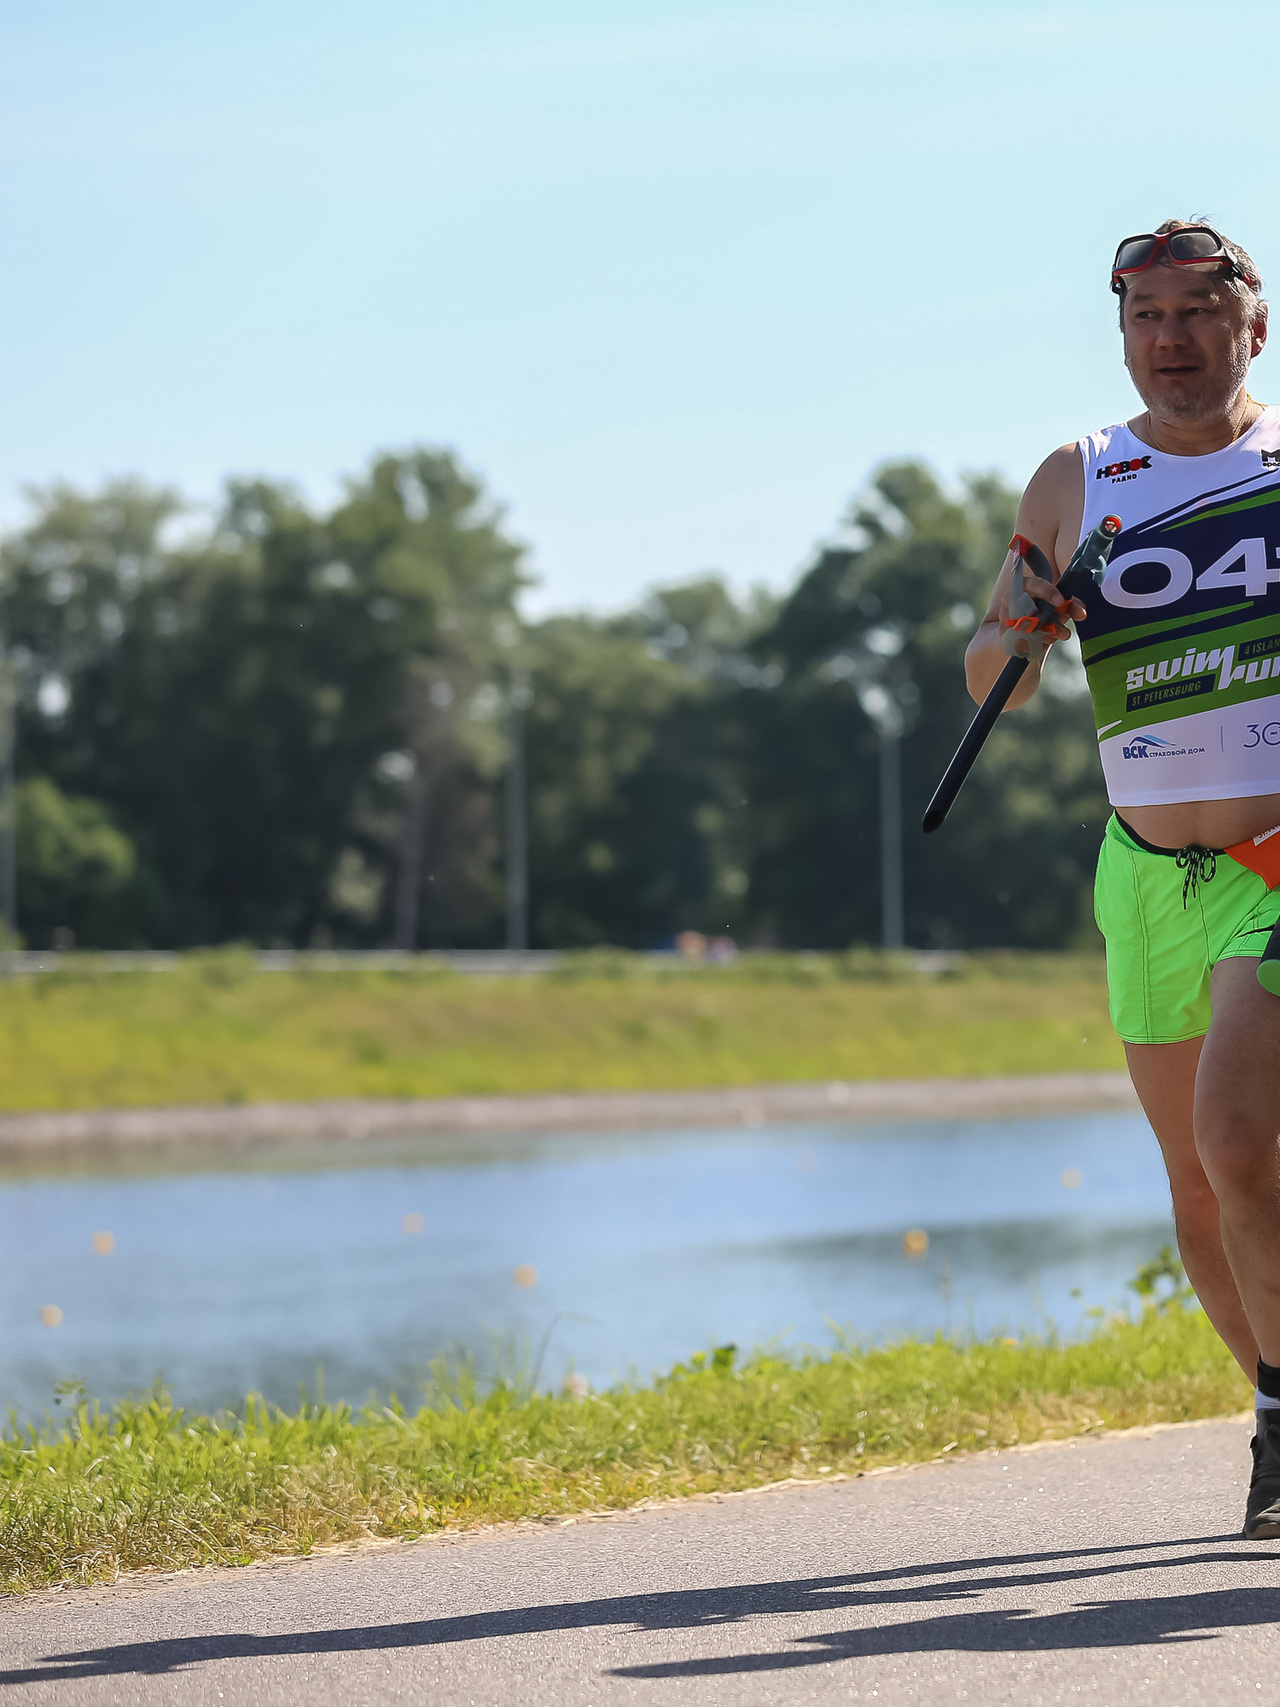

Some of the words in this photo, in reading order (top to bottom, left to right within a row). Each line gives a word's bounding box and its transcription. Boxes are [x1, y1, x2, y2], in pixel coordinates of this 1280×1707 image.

[1143, 681, 1202, 703] PETERSBURG
[1122, 745, 1150, 760] ВСК
[1149, 748, 1187, 758] СТРАХОВОЙ
[1188, 747, 1206, 755] ДОМ
